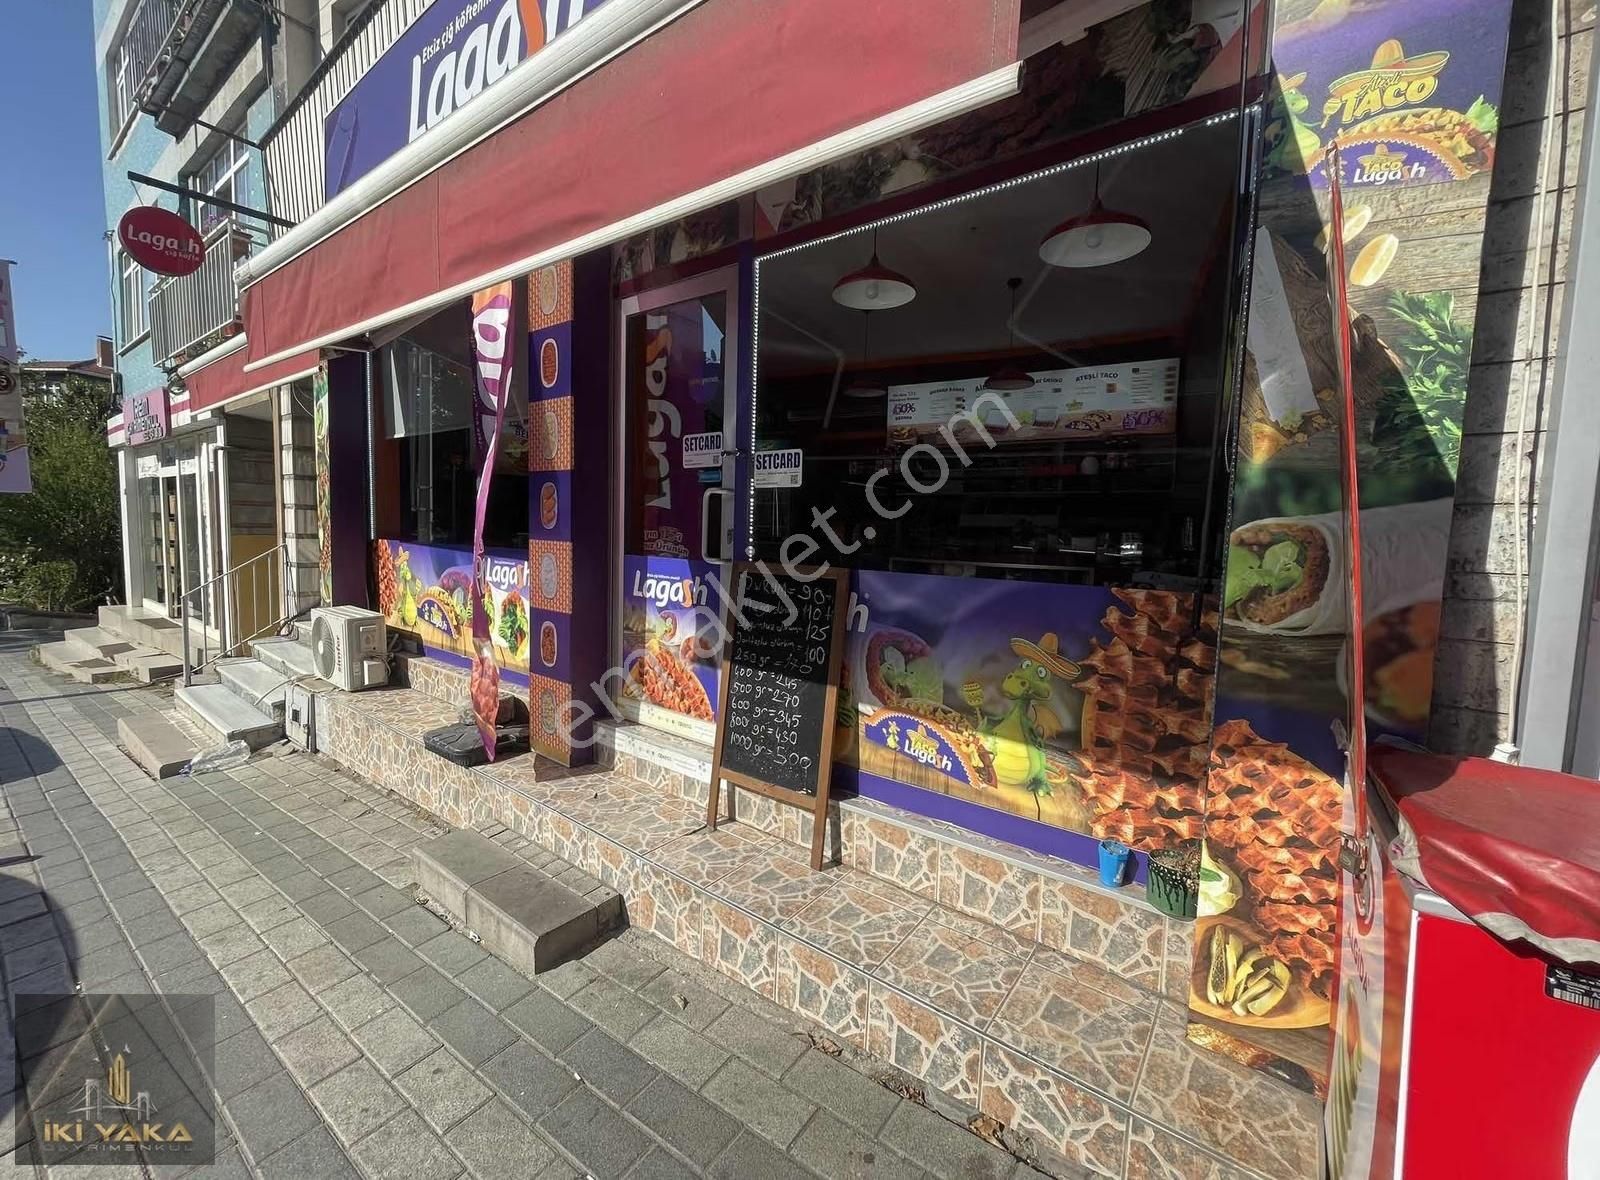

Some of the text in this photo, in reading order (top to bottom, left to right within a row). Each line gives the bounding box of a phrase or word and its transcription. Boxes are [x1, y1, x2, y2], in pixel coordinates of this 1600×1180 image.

[422, 38, 441, 64] Etsiz
[1341, 75, 1439, 124] TACO
[1353, 162, 1426, 185] Lagash
[1099, 371, 1119, 379] TACO
[684, 434, 722, 453] SETCARD
[755, 451, 801, 470] SETCARD
[633, 569, 708, 608] Lagash
[731, 681, 753, 694] 500
[772, 688, 800, 708] 270
[732, 696, 750, 710] 600
[729, 711, 749, 728] 800
[730, 731, 753, 751] 1000
[773, 745, 812, 769] 500
[904, 739, 953, 772] Lagash
